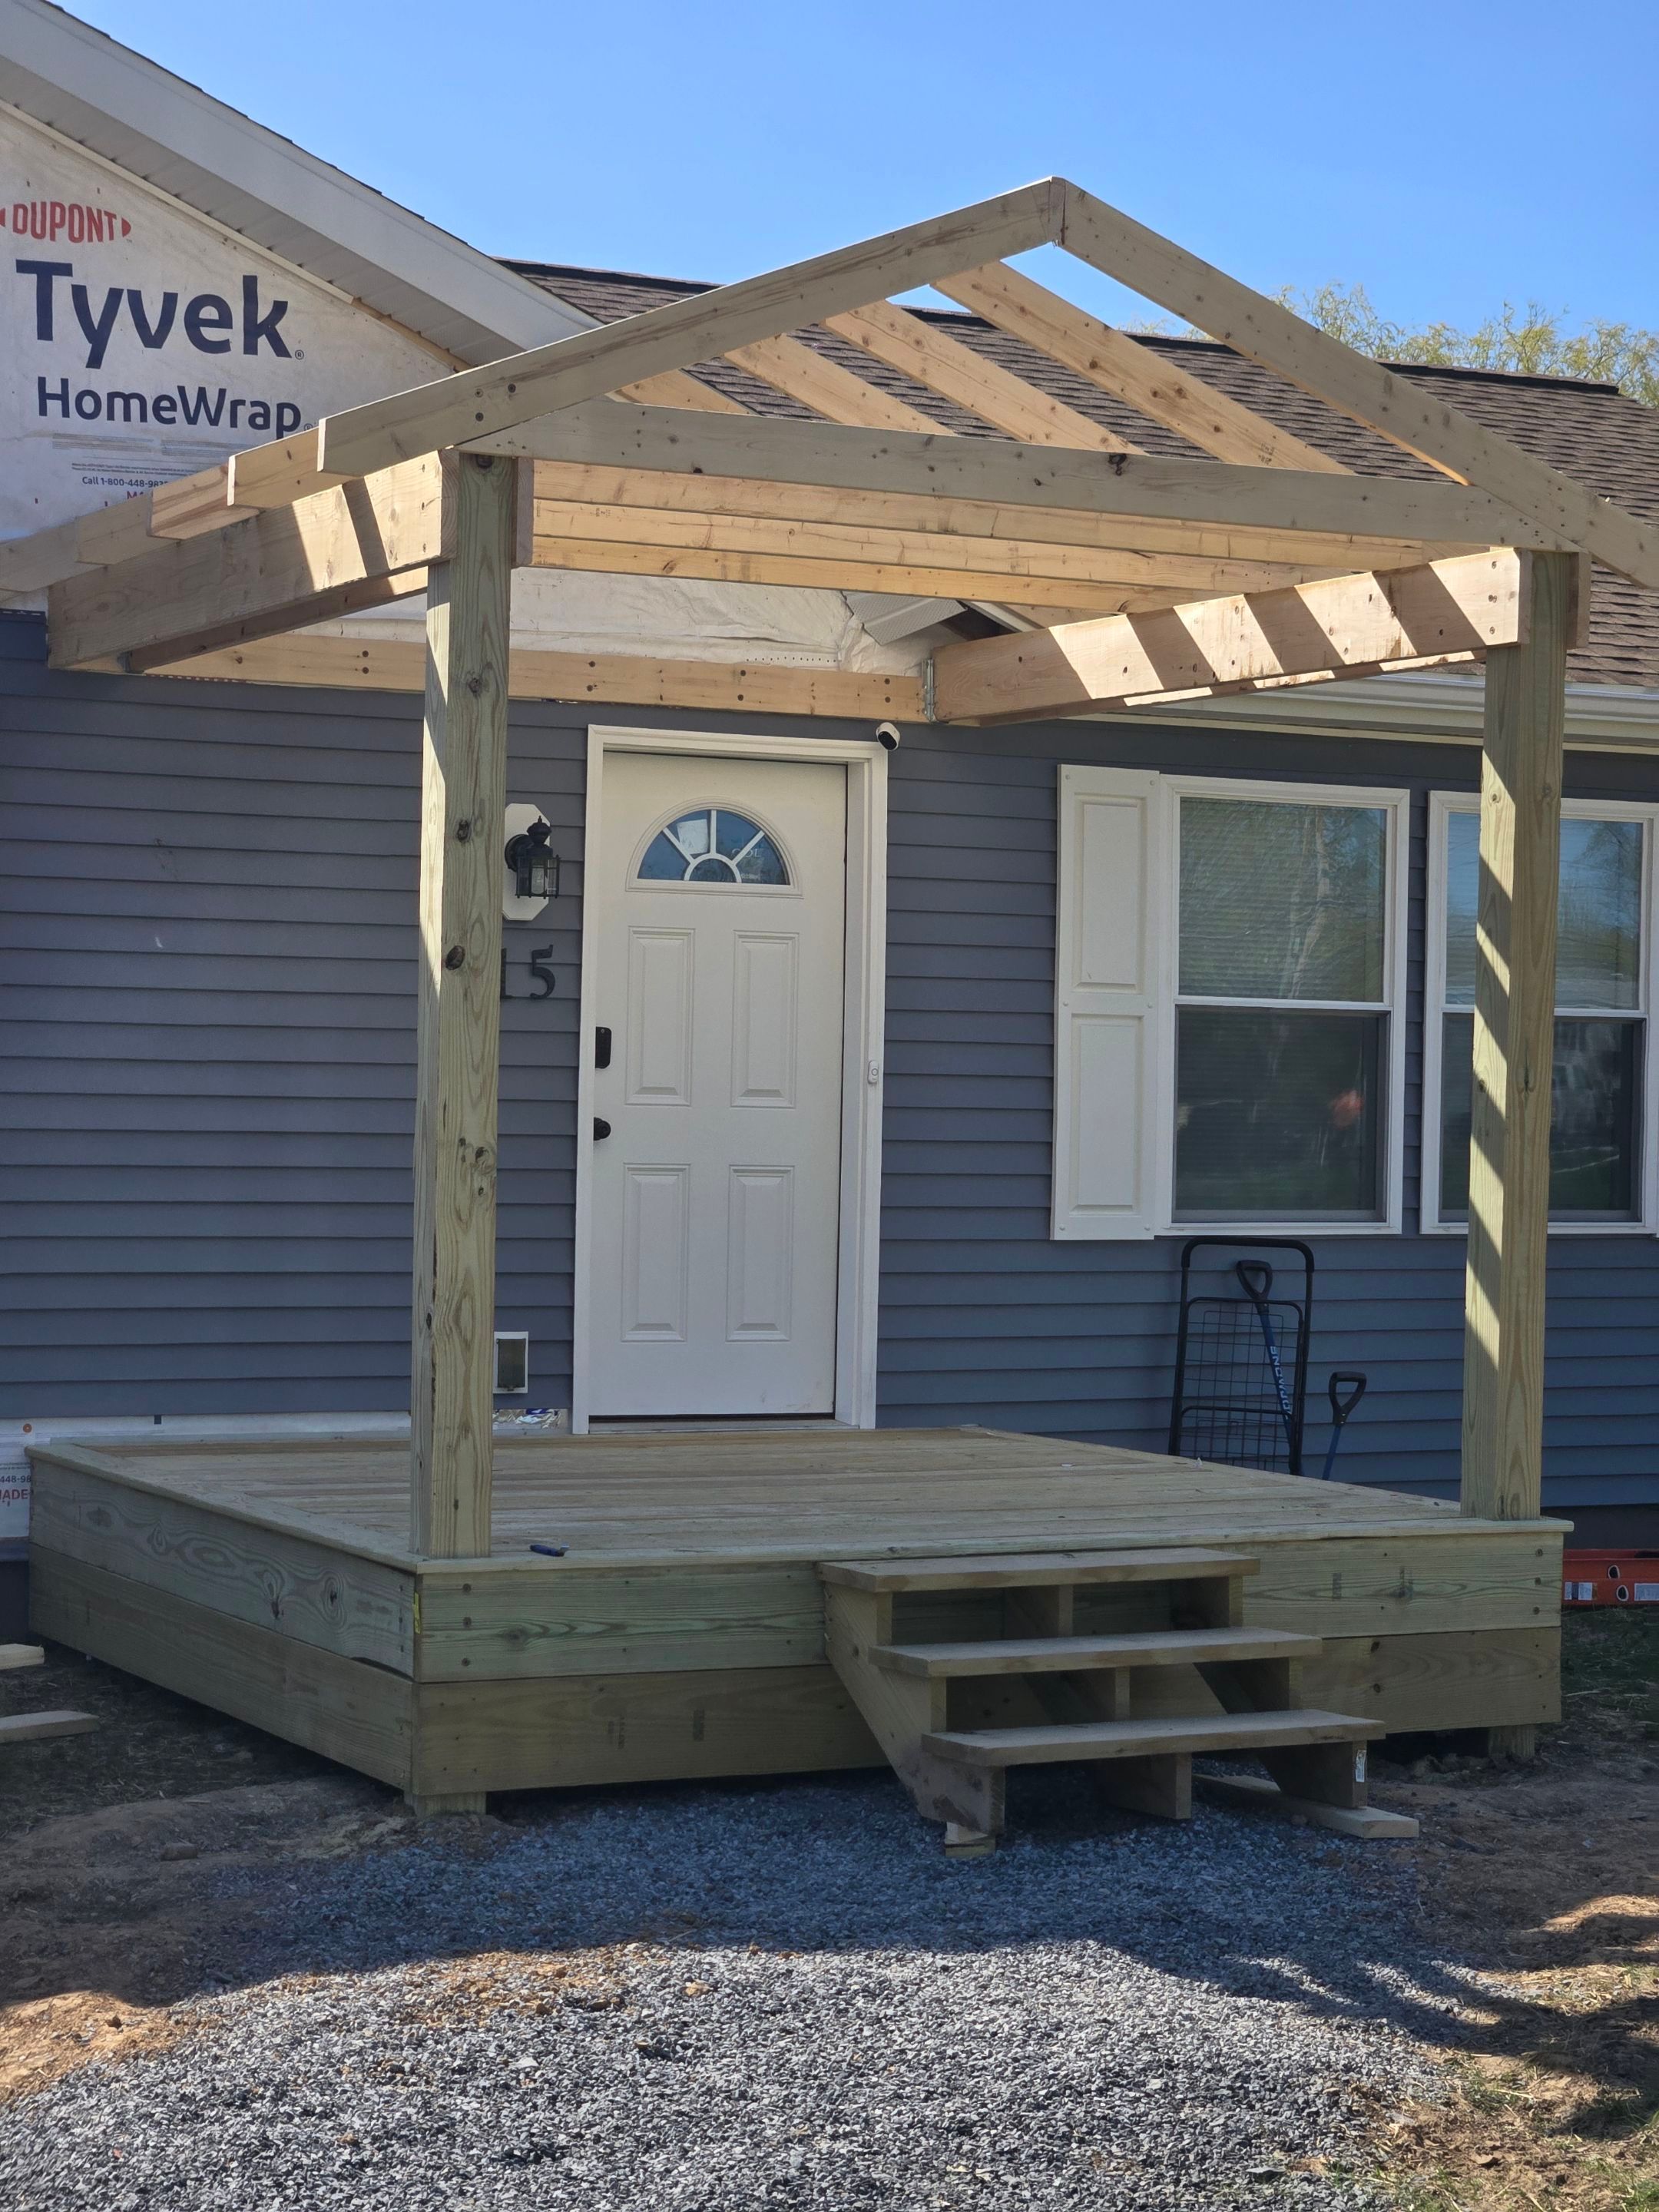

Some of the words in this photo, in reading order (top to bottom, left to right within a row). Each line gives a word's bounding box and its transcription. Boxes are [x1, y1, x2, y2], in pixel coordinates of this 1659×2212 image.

[13, 201, 117, 243] DUPONT
[81, 476, 99, 485] Call
[0, 1488, 28, 1500] ADE
